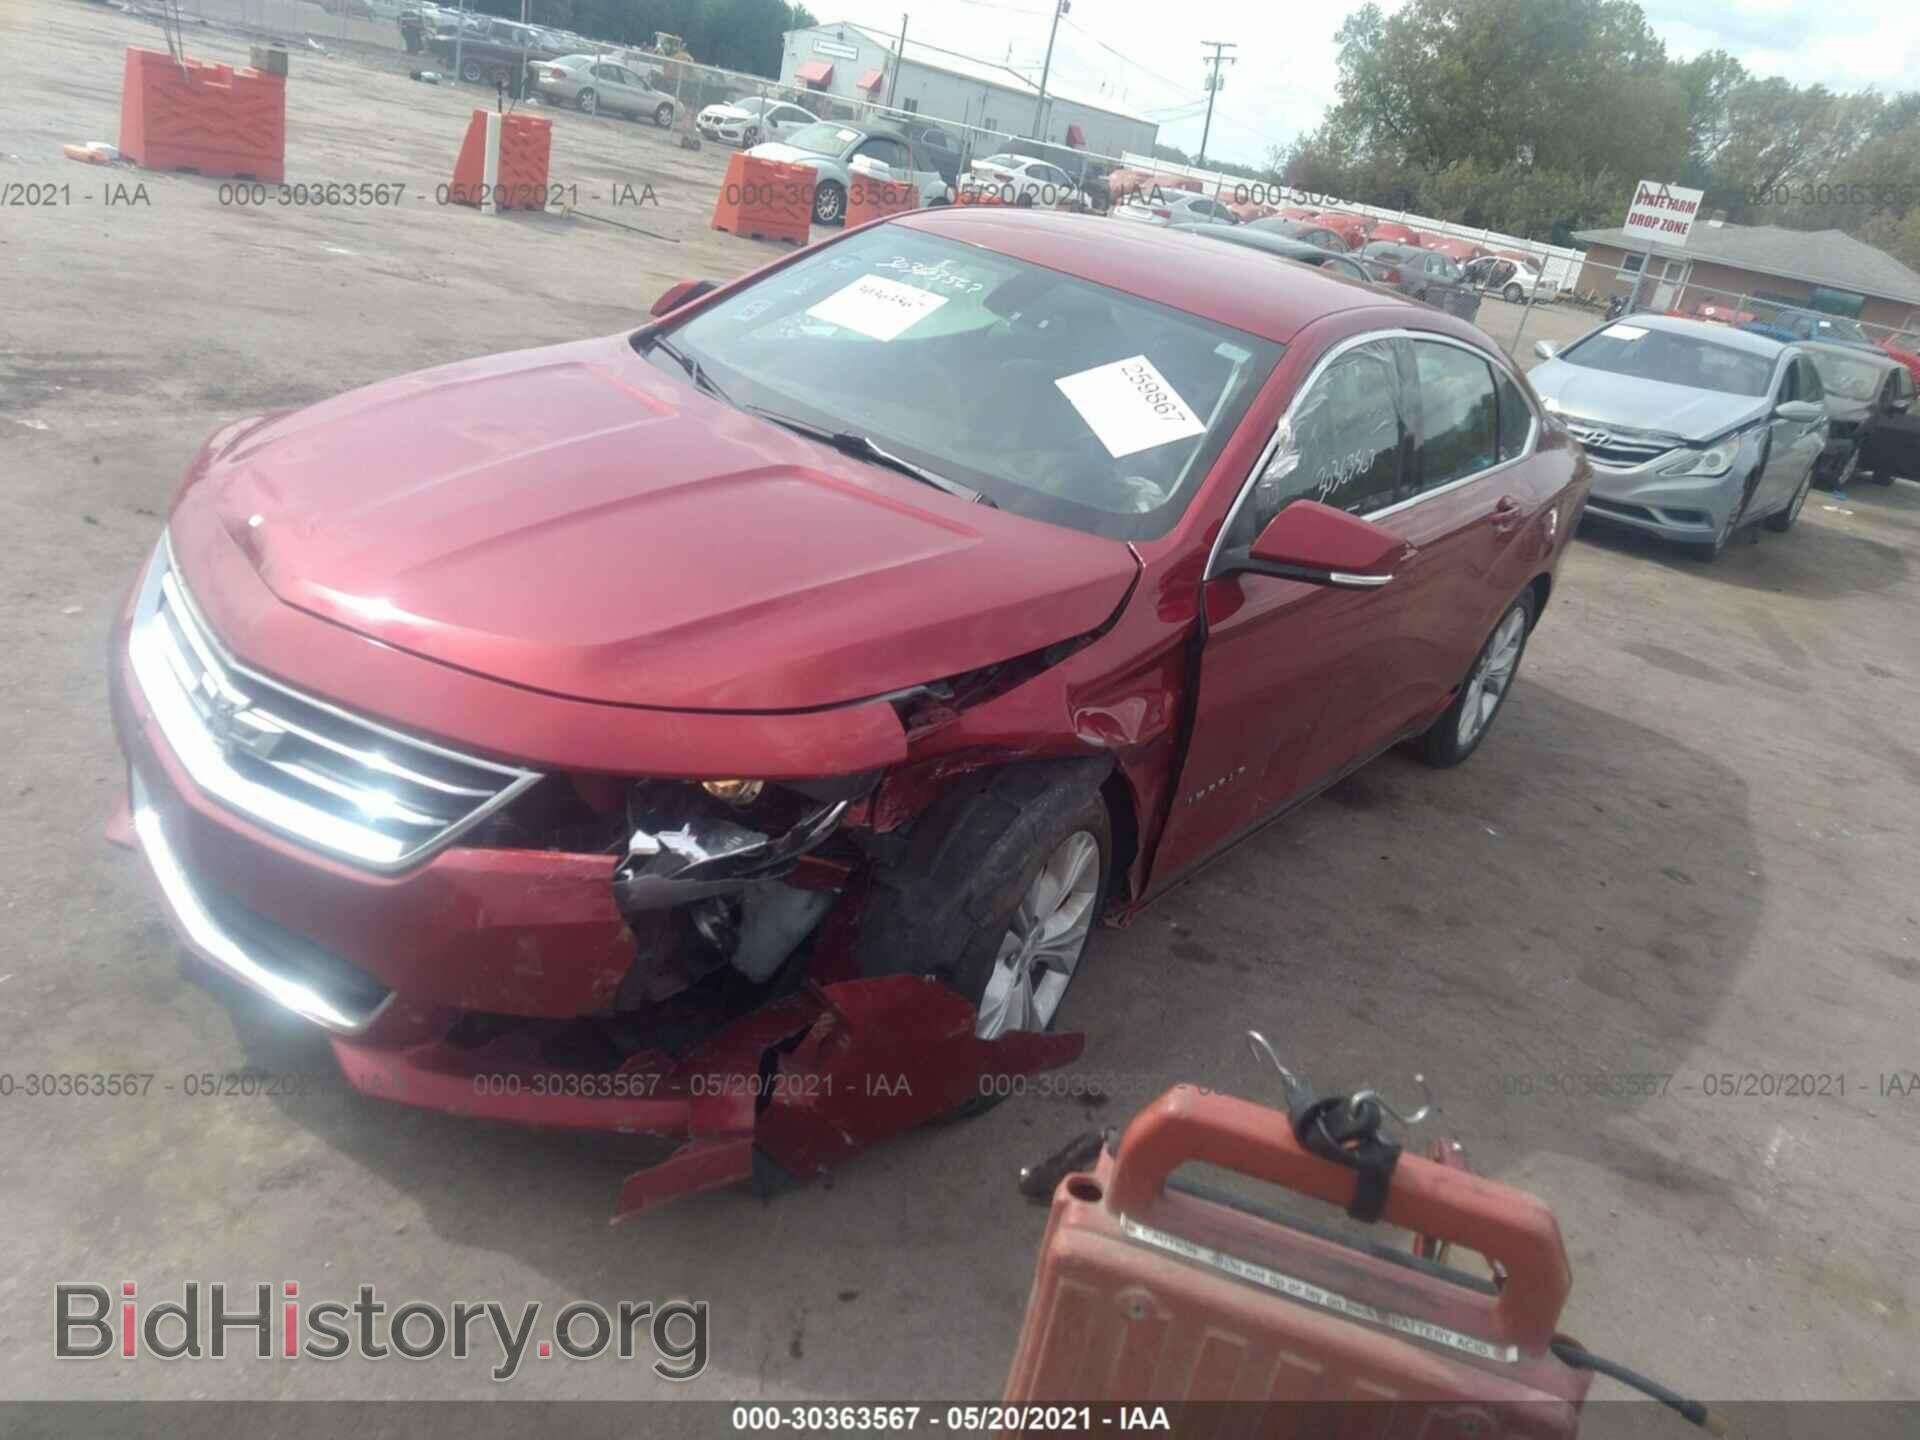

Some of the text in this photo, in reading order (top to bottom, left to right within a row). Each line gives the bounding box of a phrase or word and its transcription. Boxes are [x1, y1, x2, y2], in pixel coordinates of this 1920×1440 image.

[1635, 192, 1698, 215] STATE FARM
[1629, 212, 1689, 235] DROP ZONE
[1121, 363, 1187, 422] 259867
